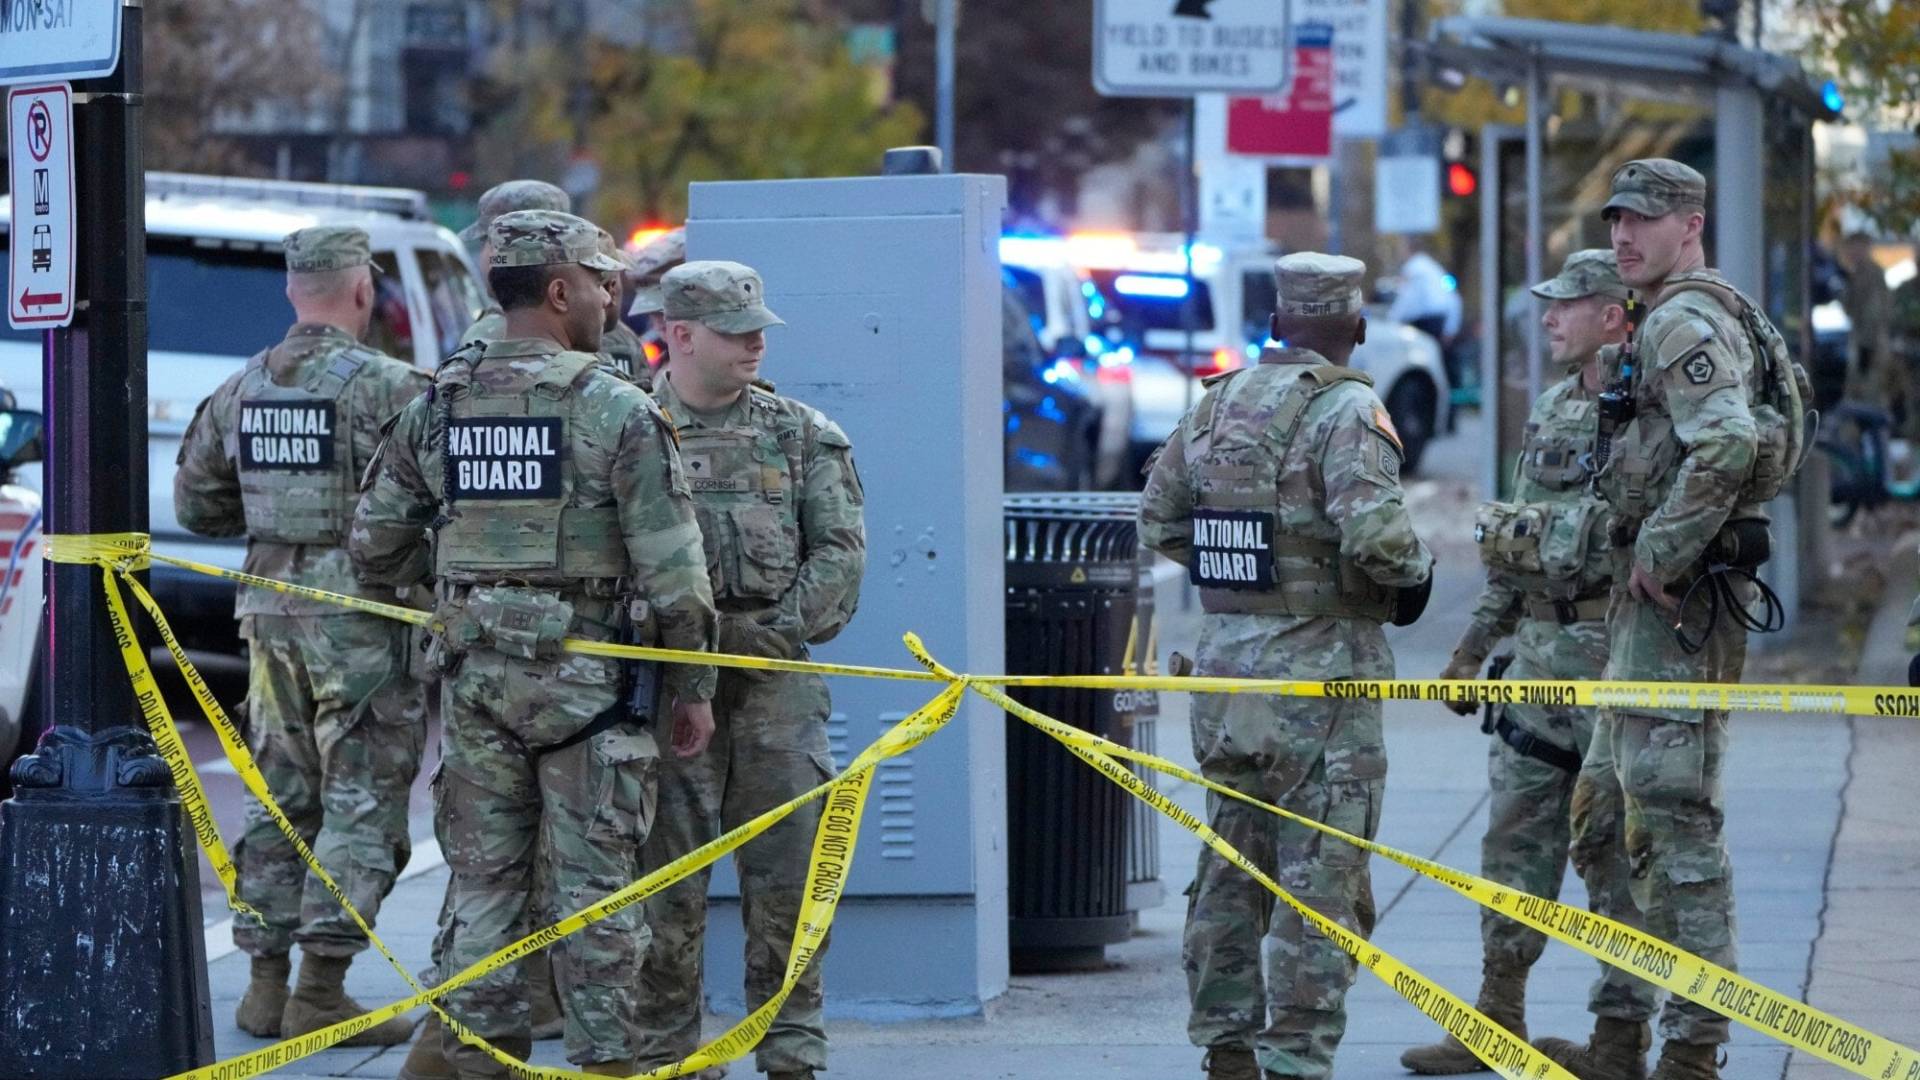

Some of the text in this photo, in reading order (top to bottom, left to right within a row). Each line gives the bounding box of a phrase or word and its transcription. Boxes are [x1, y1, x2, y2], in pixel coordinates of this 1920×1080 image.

[1105, 22, 1168, 46] YIELD
[1177, 24, 1204, 47] TO
[1138, 52, 1180, 74] AND
[1302, 303, 1330, 314] SMITH
[241, 407, 330, 436] NATIONAL
[775, 429, 797, 443] RMY
[251, 437, 320, 464] GUARD
[449, 426, 555, 456] NATIONAL
[458, 460, 542, 490] GUARD
[694, 480, 736, 490] CORNISH
[1193, 518, 1268, 550] NATIONAL
[1199, 551, 1257, 581] GUARD
[1457, 685, 1512, 703] SCENE
[1519, 686, 1577, 705] CRIME
[1874, 694, 1920, 715] ROSS
[138, 690, 167, 733] POLICE
[156, 729, 180, 760] LINE
[171, 758, 189, 788] DO
[179, 778, 200, 810] NOT
[831, 785, 860, 816] LINE
[190, 804, 219, 848] CROSS
[826, 815, 852, 833] DO
[820, 835, 849, 861] NOT
[811, 861, 844, 904] CROSS
[1515, 895, 1561, 925] POLICE
[1558, 903, 1591, 940] LINE
[1586, 920, 1610, 948] DO
[1608, 929, 1636, 962] NOT
[1632, 940, 1677, 980] CROSS
[1392, 970, 1430, 1011] CROSS
[1428, 996, 1454, 1027] NOT
[1450, 1007, 1471, 1037] DO
[1711, 977, 1872, 1066] POLICE LINE DO NOT CROSS
[1464, 1017, 1493, 1055] LINE
[1488, 1034, 1530, 1075] POLICE
